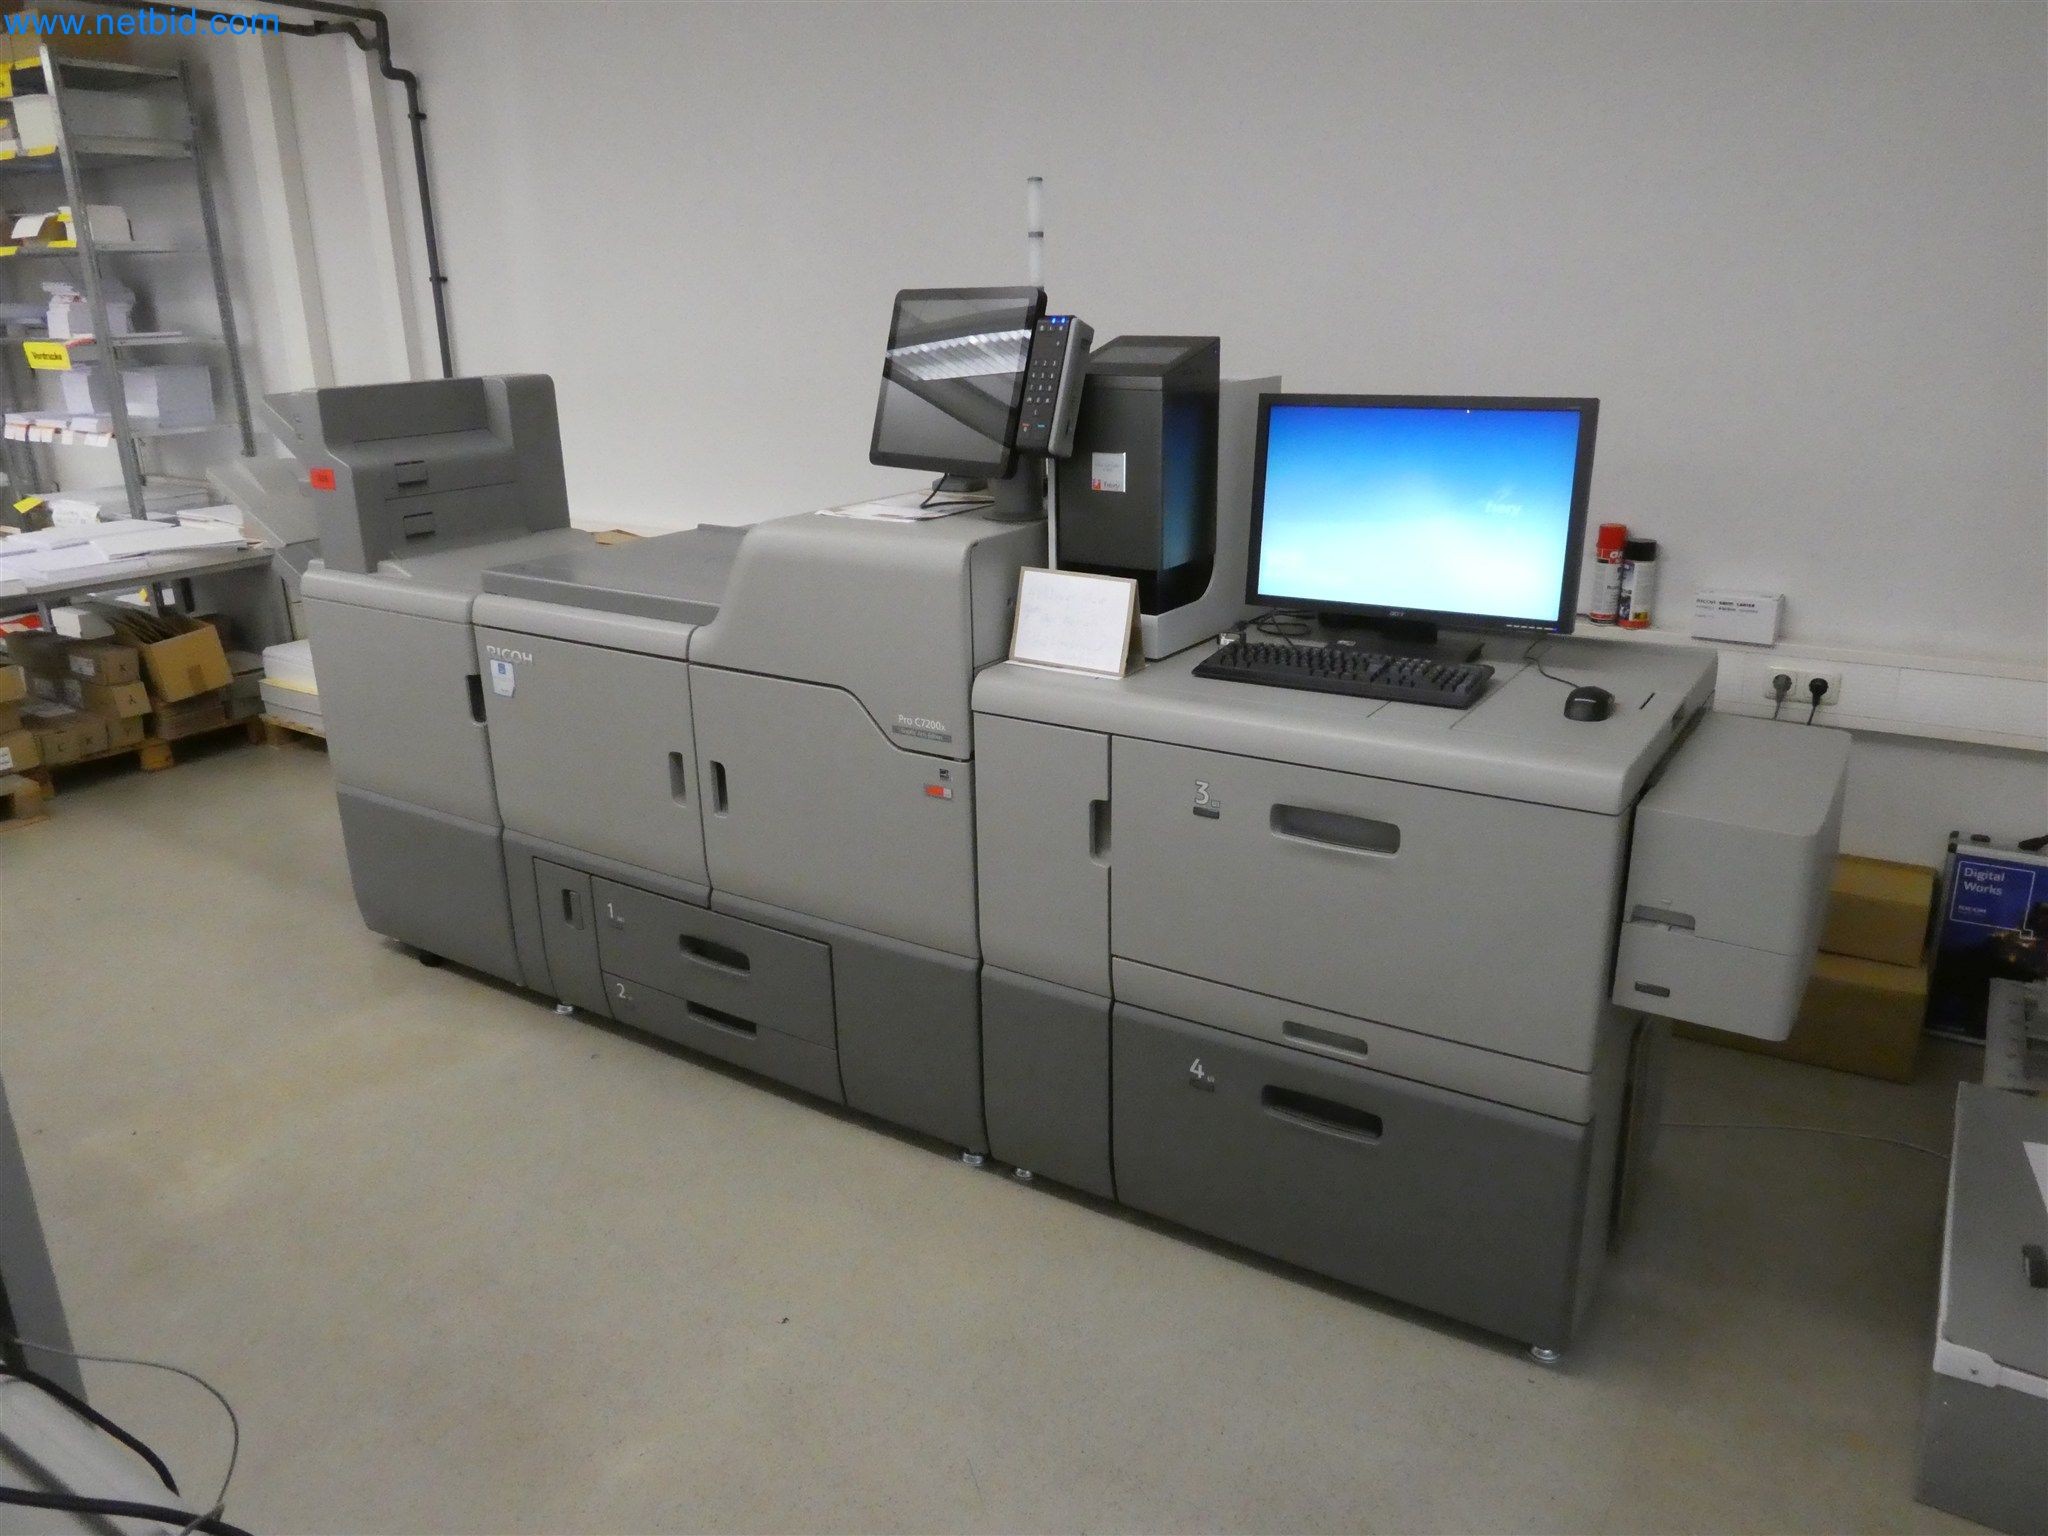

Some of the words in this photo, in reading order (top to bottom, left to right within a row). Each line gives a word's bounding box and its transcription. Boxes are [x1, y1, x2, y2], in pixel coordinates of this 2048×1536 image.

[898, 714, 913, 726] Pro
[1194, 780, 1209, 805] 3
[1963, 867, 2006, 882] Digital
[1963, 880, 2003, 896] Works
[607, 902, 614, 919] 1
[616, 983, 627, 999] 2
[1189, 1058, 1205, 1079] 4
